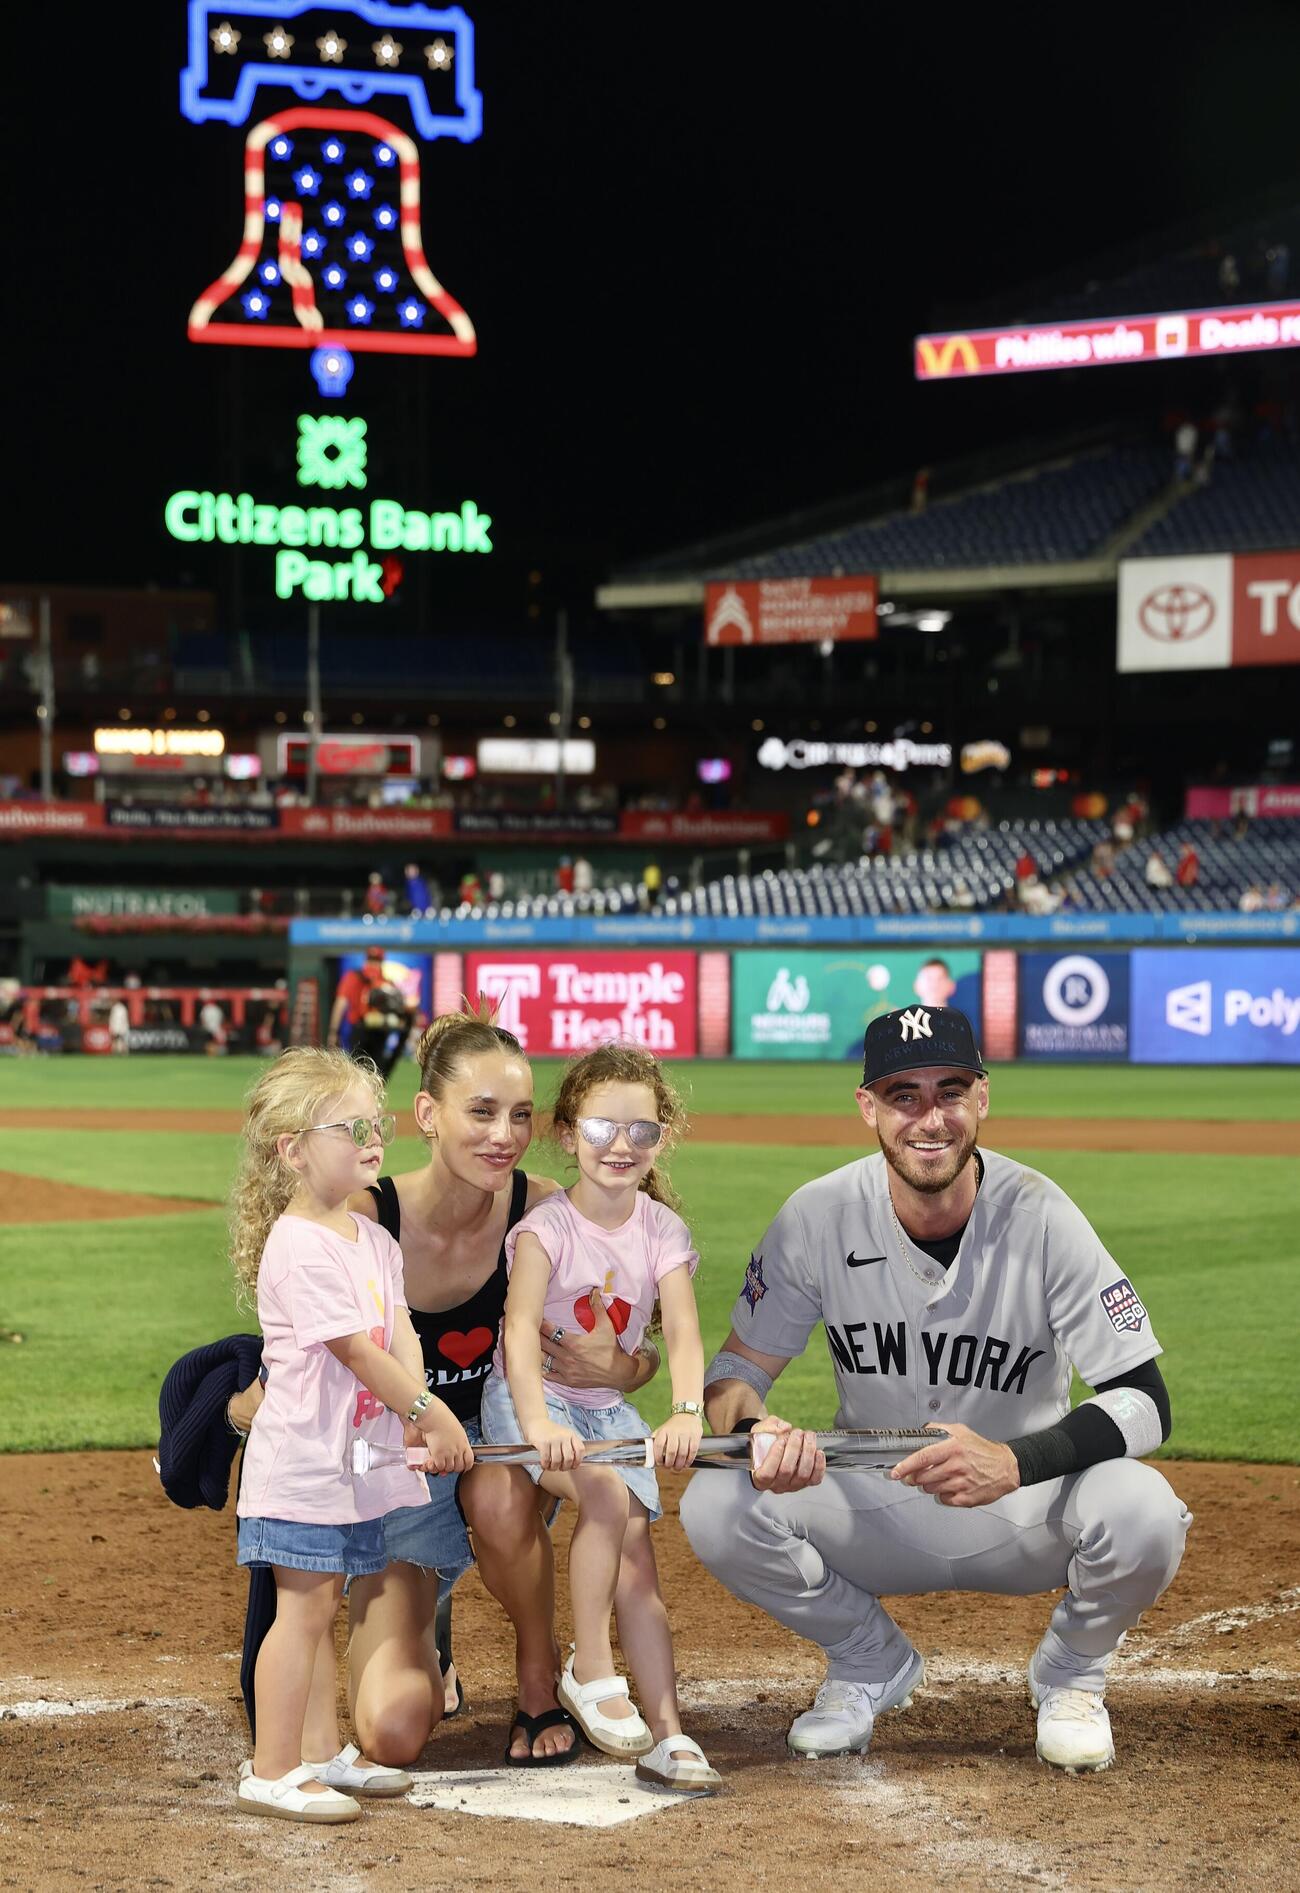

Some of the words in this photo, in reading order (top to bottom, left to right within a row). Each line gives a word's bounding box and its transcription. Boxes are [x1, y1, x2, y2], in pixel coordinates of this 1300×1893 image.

[1091, 325, 1143, 357] win
[165, 491, 364, 548] Citizens
[370, 500, 492, 553] Bank
[276, 550, 384, 602] Park
[548, 962, 685, 1013] Temple
[551, 1009, 676, 1050] Health
[899, 1007, 934, 1042] NY
[1224, 987, 1300, 1036] Poly
[1102, 1285, 1131, 1307] USA
[1112, 1303, 1145, 1332] 250
[827, 1321, 907, 1376] NEW
[921, 1330, 1047, 1395] YORK
